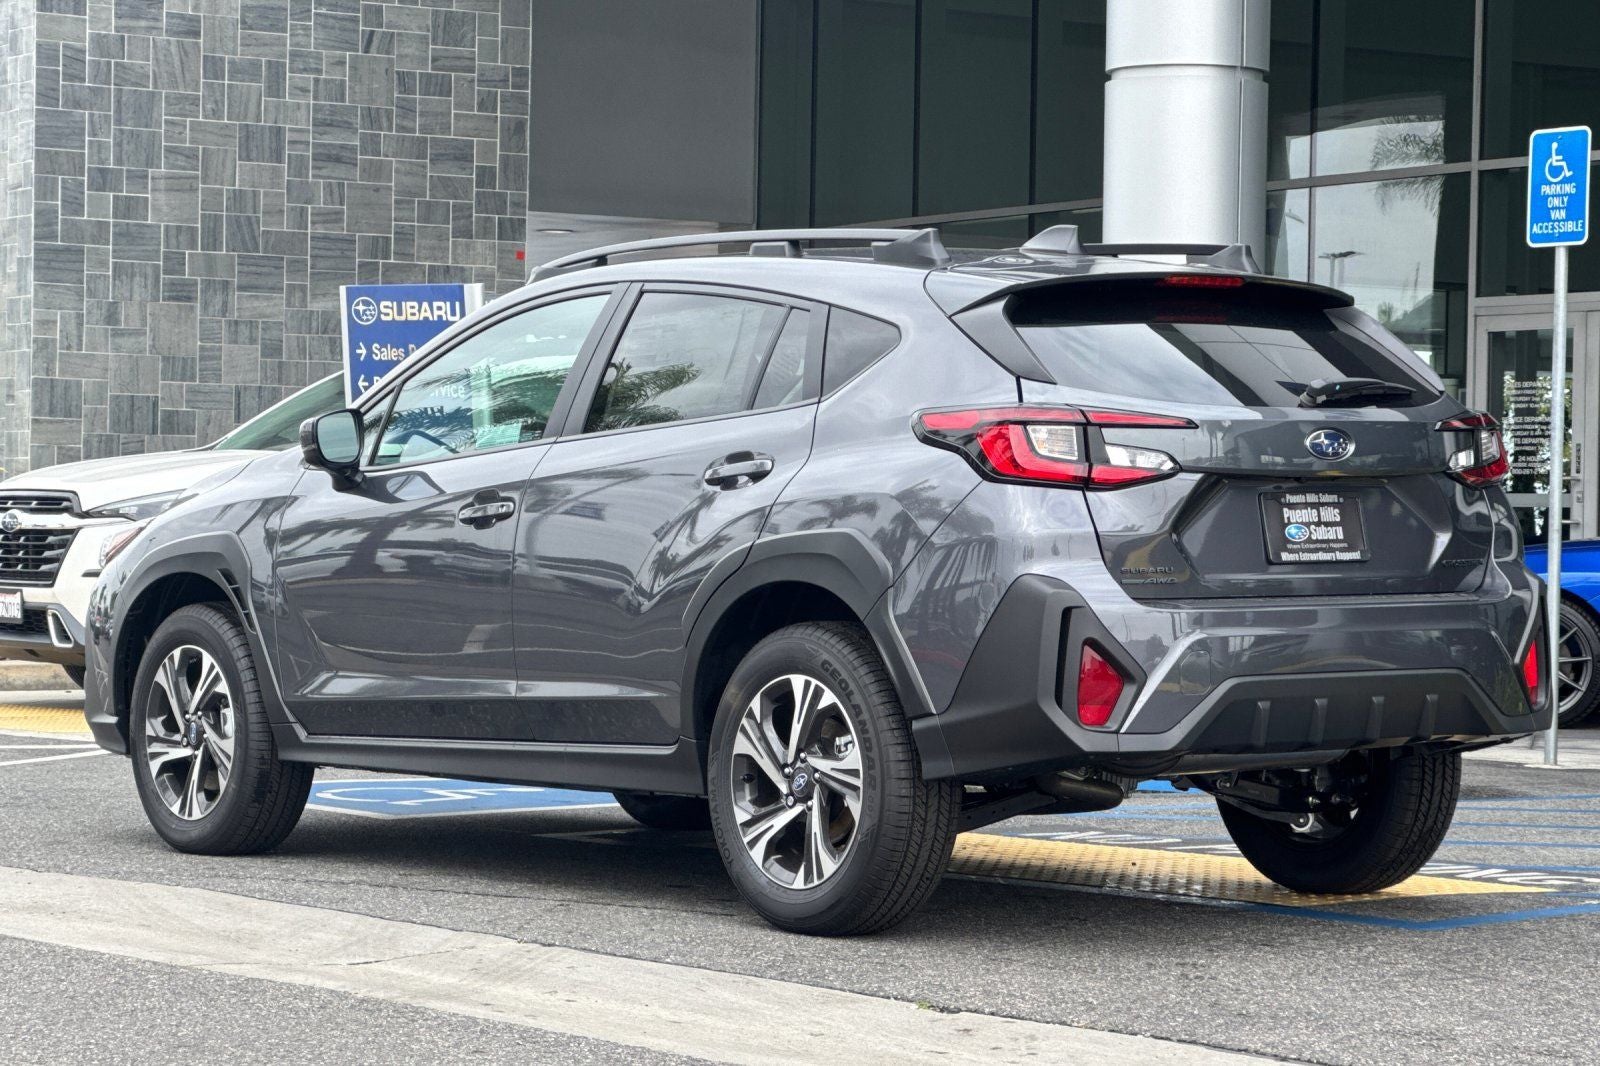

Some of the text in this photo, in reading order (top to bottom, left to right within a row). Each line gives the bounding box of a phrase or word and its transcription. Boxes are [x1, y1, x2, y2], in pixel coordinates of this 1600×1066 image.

[1541, 182, 1577, 196] PARKING
[1547, 195, 1569, 208] ONLY
[1550, 209, 1566, 220] VAN
[1532, 219, 1584, 234] ACCESSIBLE
[379, 301, 460, 322] SUBARU
[372, 343, 405, 361] Sales
[1283, 506, 1340, 523] Puente Hills
[1310, 524, 1344, 540] Subaru
[1280, 552, 1300, 561] Where
[1300, 551, 1336, 561] Extraordinary
[820, 659, 877, 792] GEOLANDAR
[709, 776, 733, 868] YOKOHAMA
